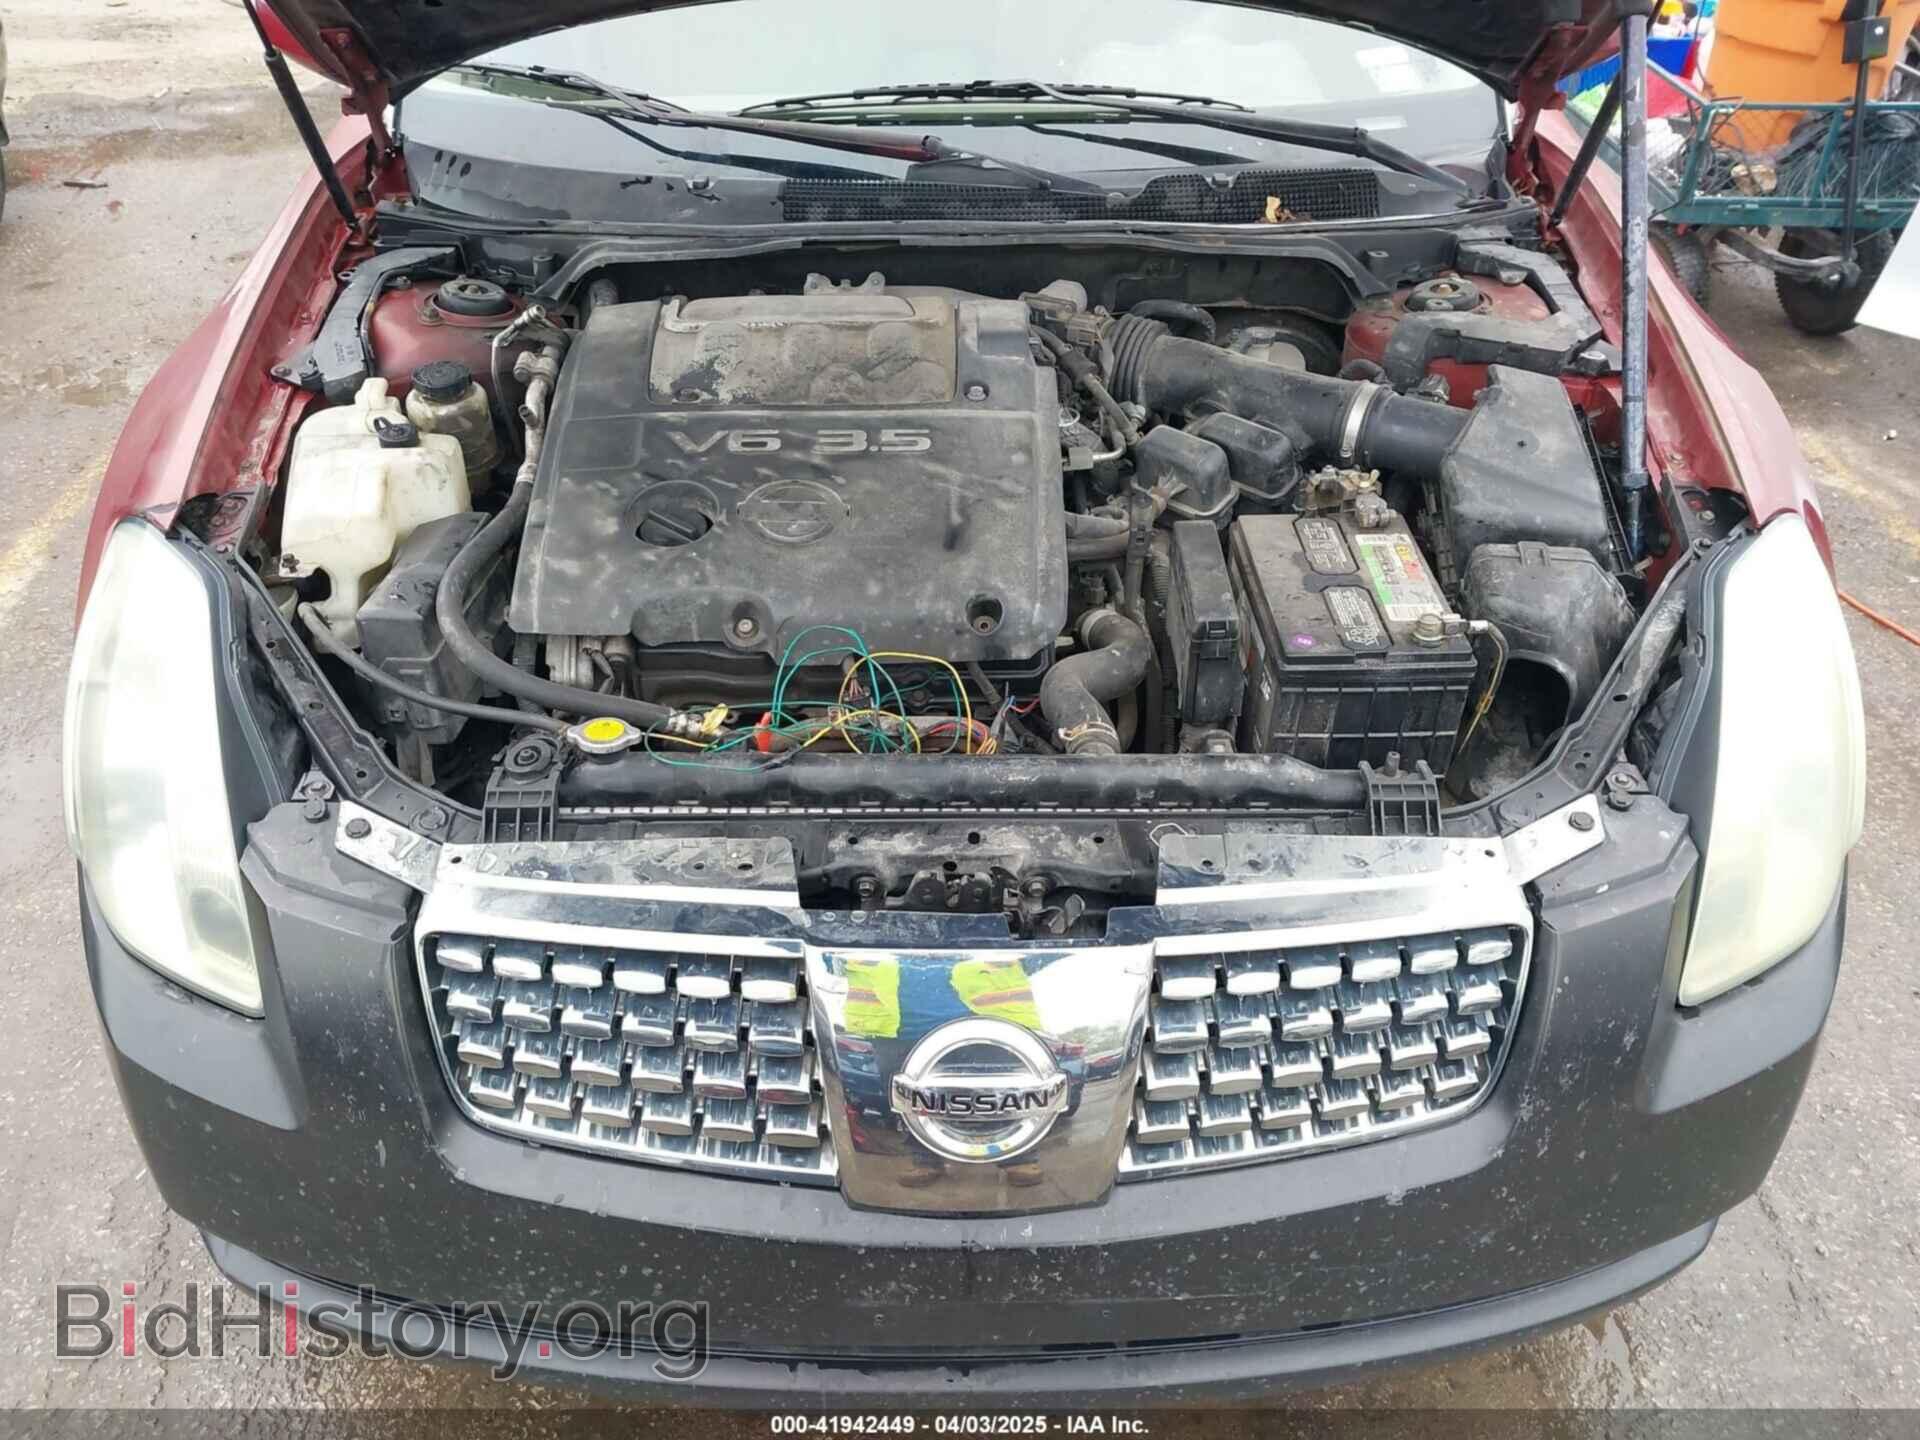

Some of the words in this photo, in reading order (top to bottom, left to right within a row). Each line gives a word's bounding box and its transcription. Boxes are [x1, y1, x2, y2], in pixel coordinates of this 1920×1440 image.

[665, 429, 782, 453] V6
[811, 429, 932, 453] 3.5
[911, 1088, 1049, 1114] NISSAN
